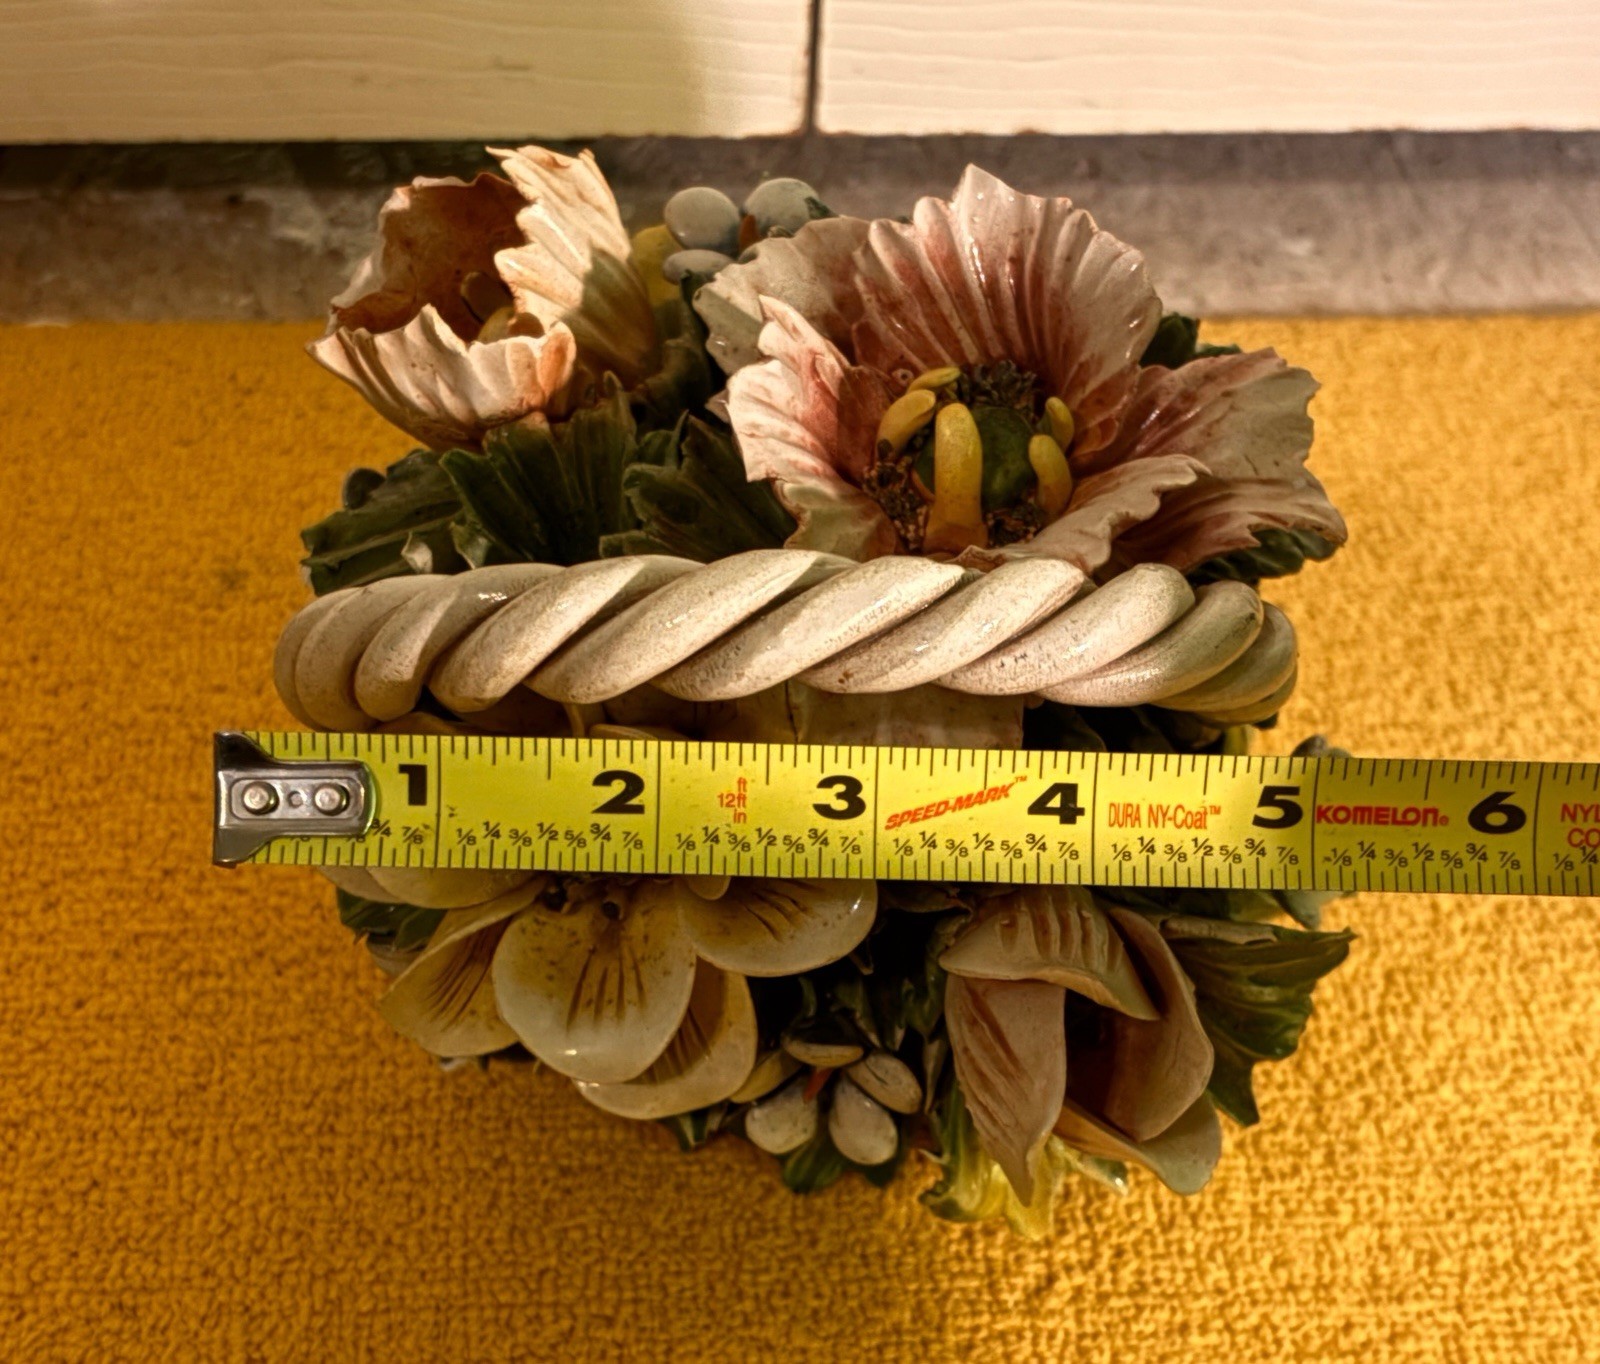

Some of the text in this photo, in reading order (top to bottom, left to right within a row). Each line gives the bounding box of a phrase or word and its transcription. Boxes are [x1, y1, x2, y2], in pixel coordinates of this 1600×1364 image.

[398, 764, 427, 806] 1
[591, 769, 645, 814] 2
[737, 777, 747, 792] ft
[812, 775, 867, 820] 3
[1027, 782, 1085, 825] 4
[733, 809, 747, 824] in
[1108, 802, 1141, 828] DURA
[1252, 785, 1304, 830] 5
[1467, 791, 1527, 835] 6
[1567, 827, 1600, 849] CO
